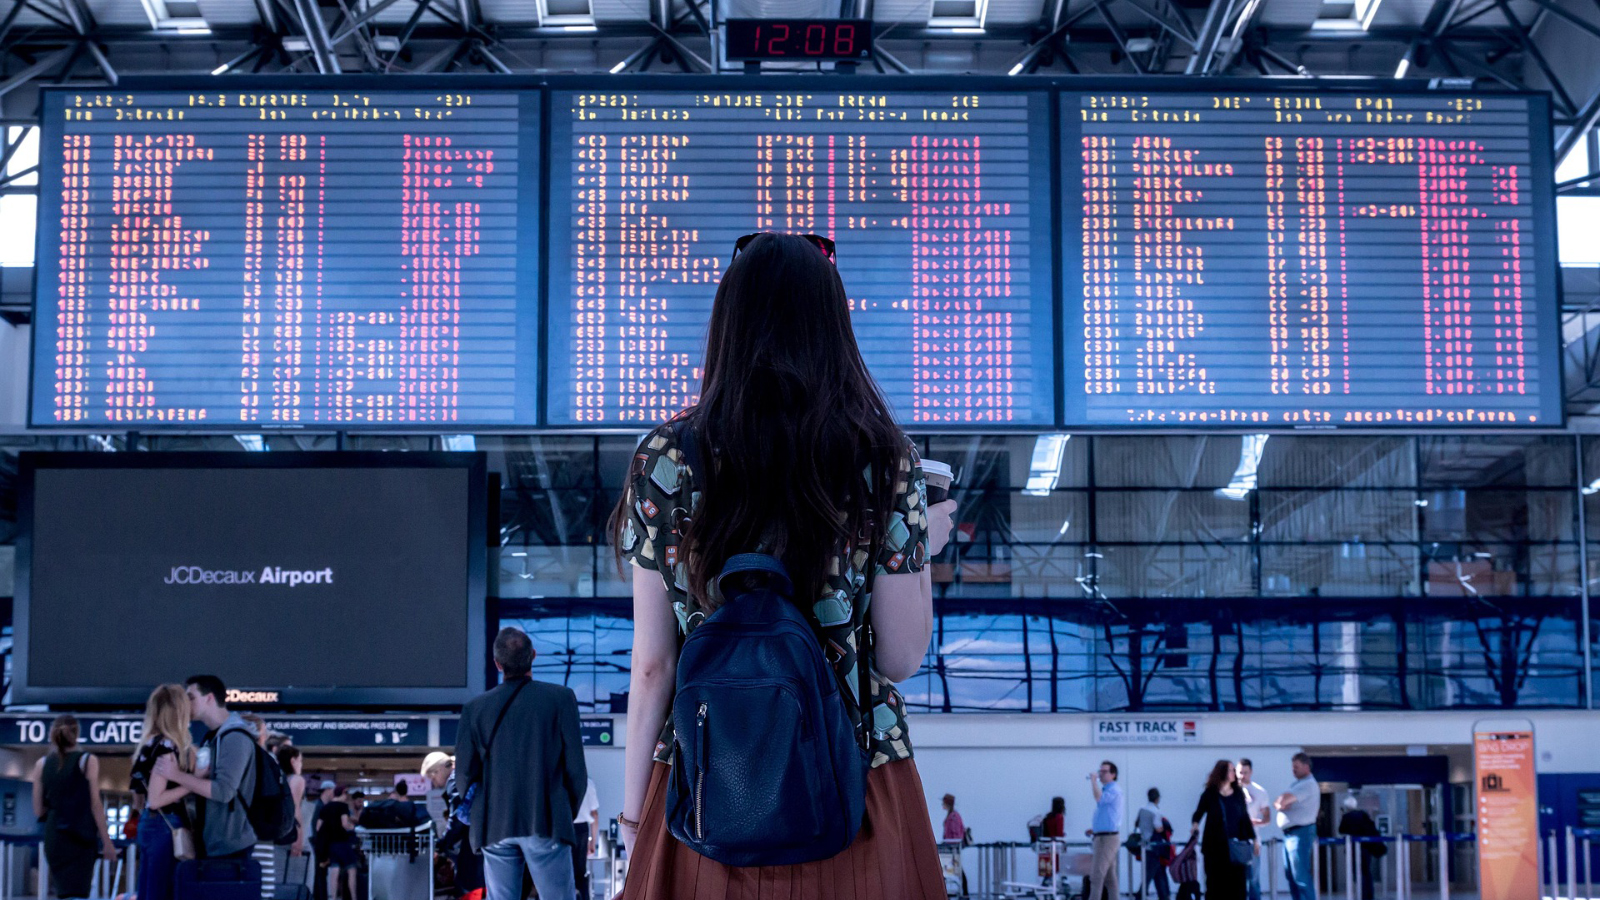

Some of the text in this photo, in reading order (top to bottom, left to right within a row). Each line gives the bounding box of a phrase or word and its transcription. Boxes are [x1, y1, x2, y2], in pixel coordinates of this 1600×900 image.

[754, 24, 855, 55] 12:08
[163, 566, 333, 587] JCDecaux Airport
[16, 720, 46, 742] TO
[273, 721, 290, 730] YOUR
[291, 721, 323, 730] PASSPORT
[323, 721, 337, 730] AND
[337, 721, 370, 730] BOARDING
[370, 721, 386, 730] PASS
[386, 721, 408, 730] READY
[1099, 721, 1130, 733] FAST
[1135, 721, 1176, 733] TRACK
